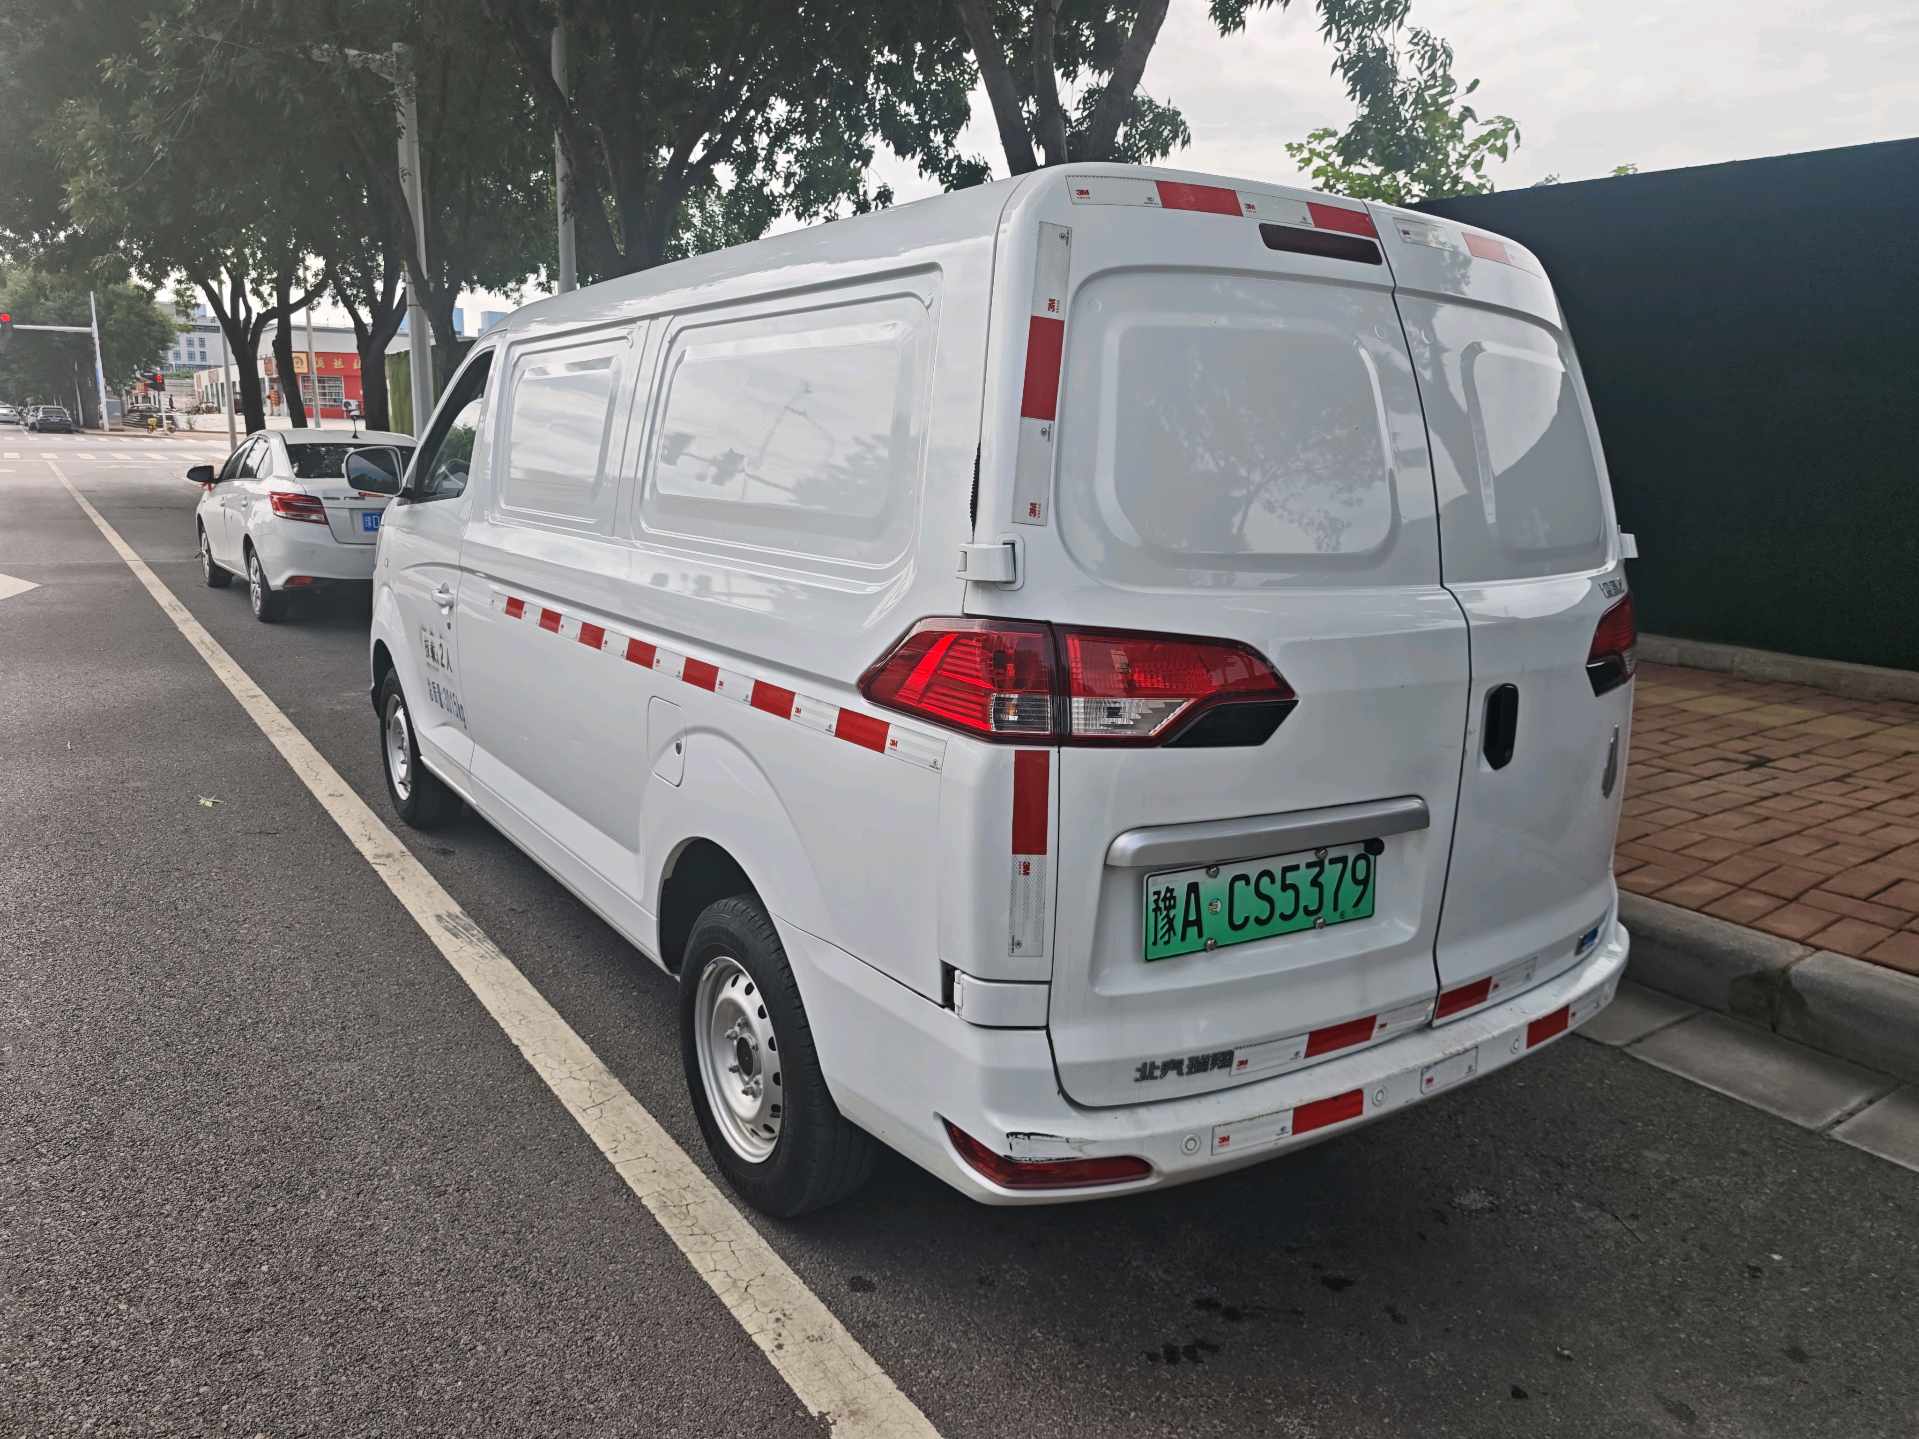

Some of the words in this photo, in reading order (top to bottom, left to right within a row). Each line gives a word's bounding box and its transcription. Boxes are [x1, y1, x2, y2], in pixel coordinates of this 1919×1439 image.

[1048, 298, 1056, 312] 3M
[1028, 502, 1037, 517] 3M
[1236, 1059, 1249, 1067] 3M
[1217, 1135, 1230, 1144] 3M
